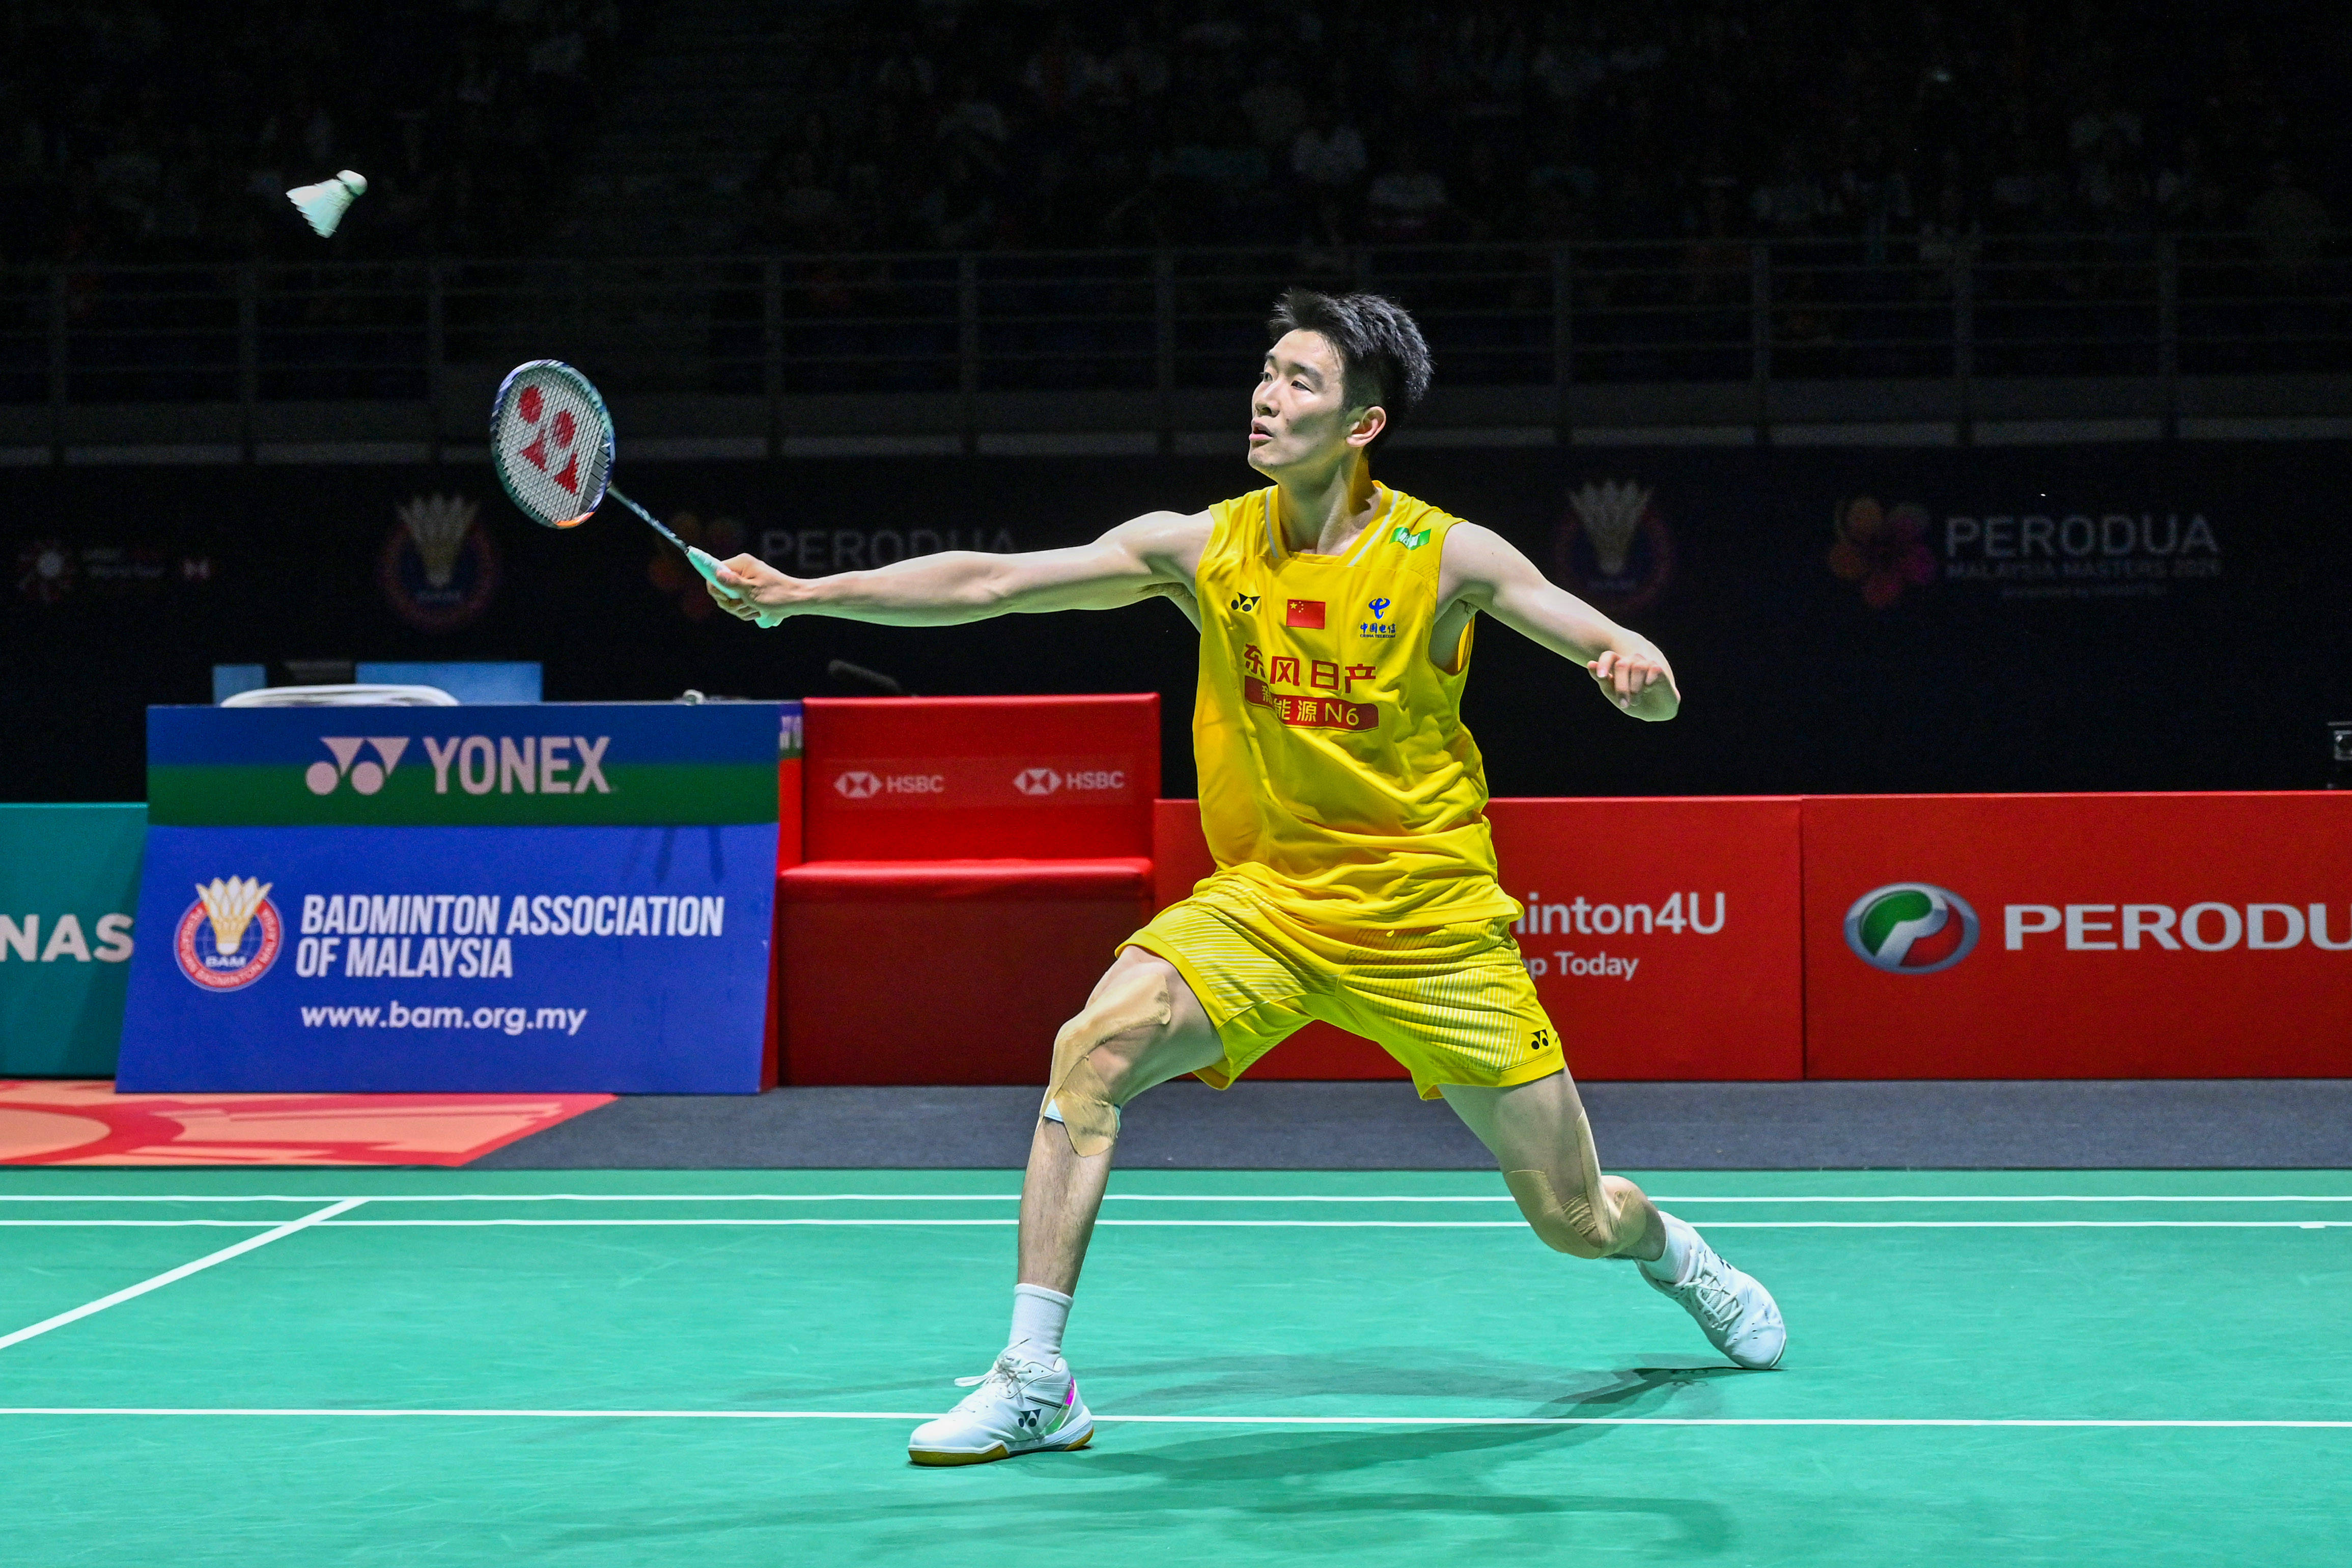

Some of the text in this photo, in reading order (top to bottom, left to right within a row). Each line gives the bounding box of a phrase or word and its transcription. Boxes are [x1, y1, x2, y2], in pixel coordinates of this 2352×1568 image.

[1946, 514, 2219, 556] PERODUA
[1360, 622, 1396, 634] 中国电信
[1244, 643, 1376, 693] 东风日产
[423, 735, 610, 794] YONEX
[886, 775, 945, 793] HSBC
[1067, 771, 1125, 790] HSBC
[301, 894, 724, 936] BADMINTON ASSOCIATION
[1516, 891, 1725, 934] inton4U
[2004, 902, 2352, 952] PERODU
[0, 913, 134, 962] NAS
[296, 937, 341, 978] OF
[345, 937, 513, 978] MALAYSIA
[206, 956, 246, 967] BAM
[1522, 950, 1639, 982] p Today
[301, 1000, 587, 1035] www.bam.org.my
